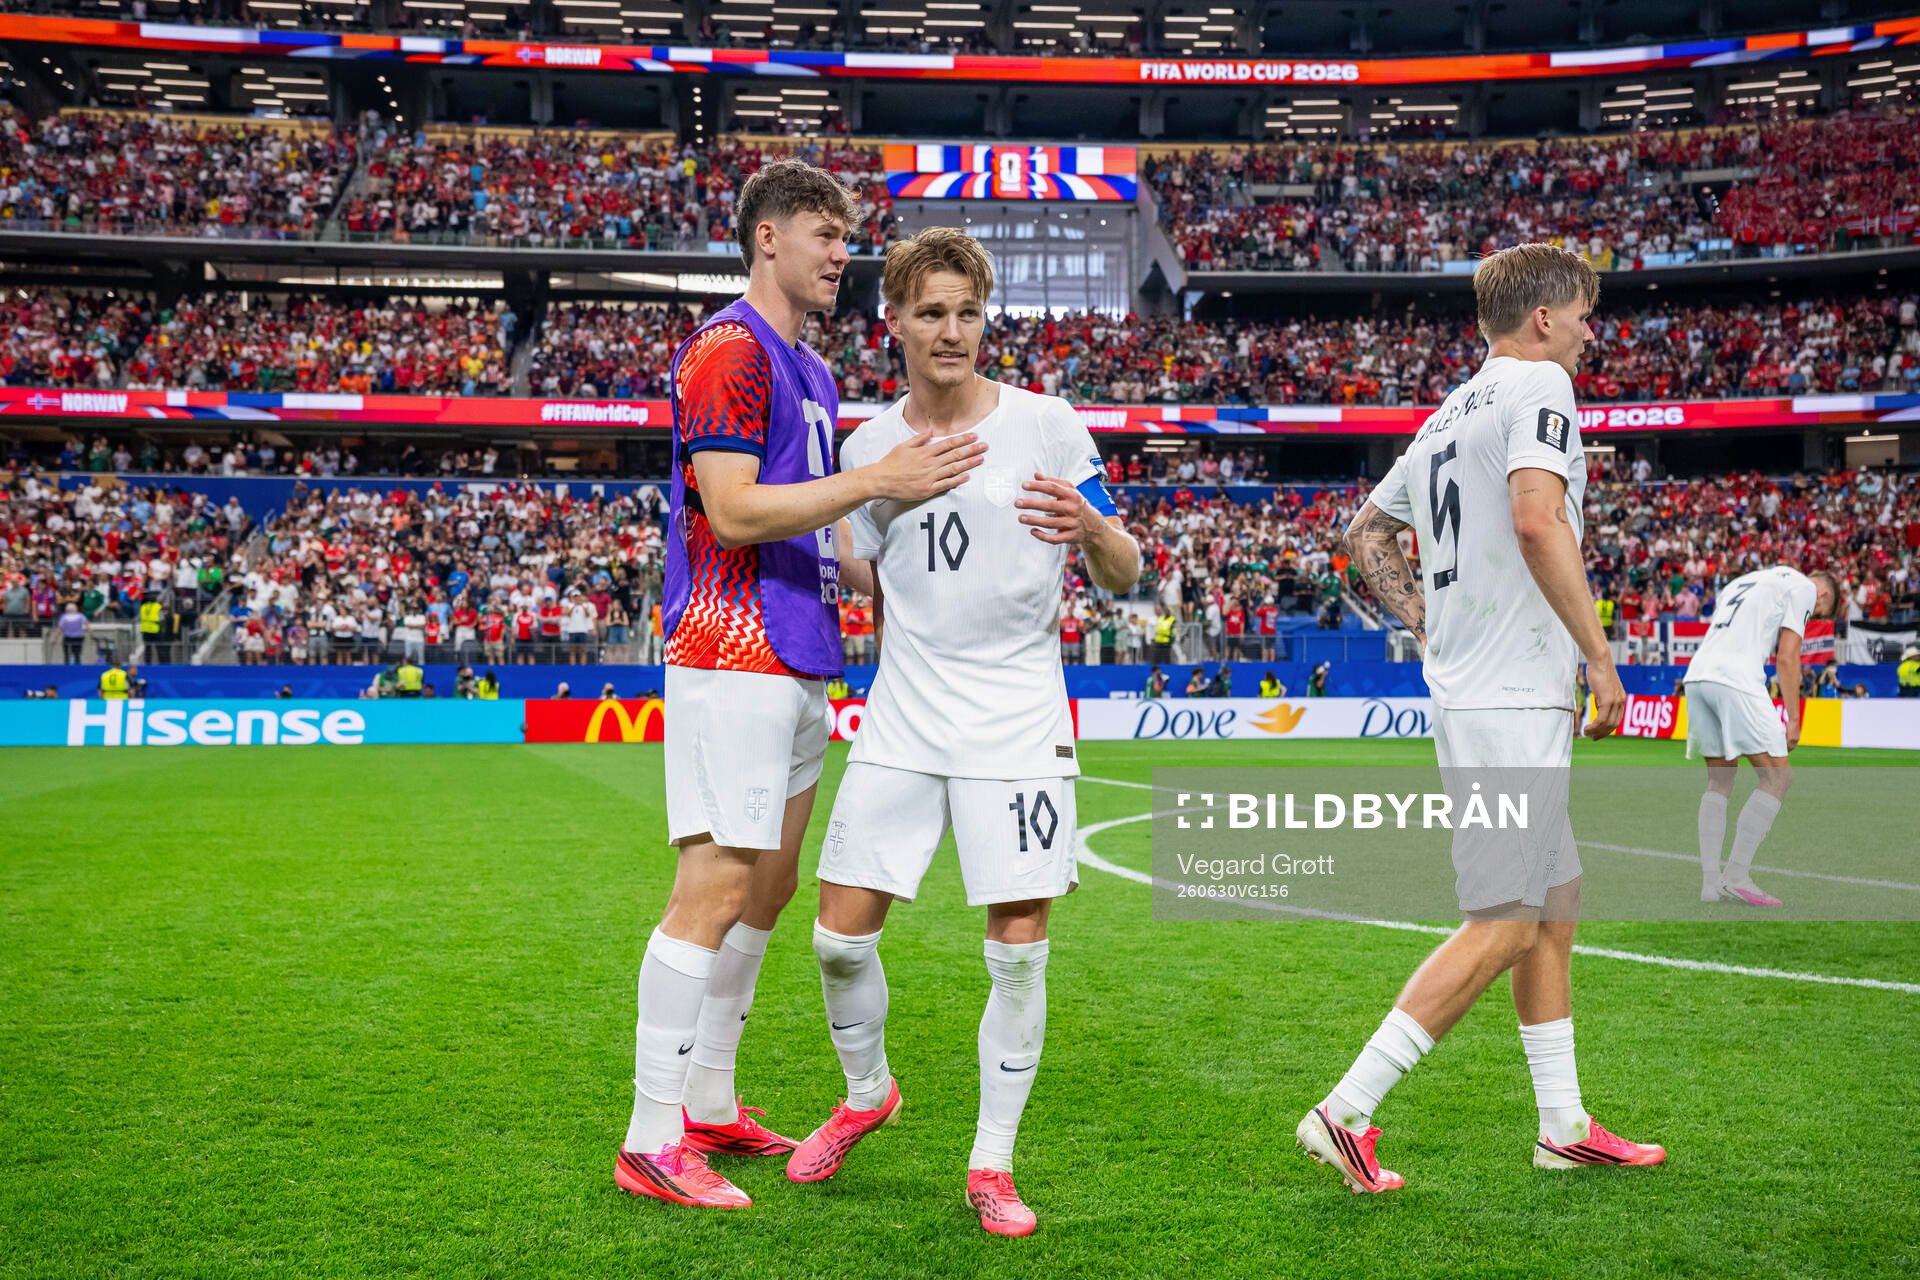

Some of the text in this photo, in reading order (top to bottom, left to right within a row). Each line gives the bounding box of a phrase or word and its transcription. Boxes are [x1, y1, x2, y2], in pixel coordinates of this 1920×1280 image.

[545, 47, 602, 65] NORWAY
[1140, 63, 1359, 80] FIFA WORLD CUP 2026
[61, 392, 128, 413] NORWAY
[541, 403, 649, 425] #FIFAWorldCup
[1577, 406, 1684, 428] UP 2026
[1430, 440, 1461, 591] 5
[920, 511, 969, 572] 10
[1714, 581, 1758, 629] 3
[67, 698, 365, 746] Hisense
[1134, 700, 1236, 739] Dove
[1360, 698, 1433, 738] Dov
[1622, 694, 1673, 738] Lay's
[1009, 790, 1058, 852] 10
